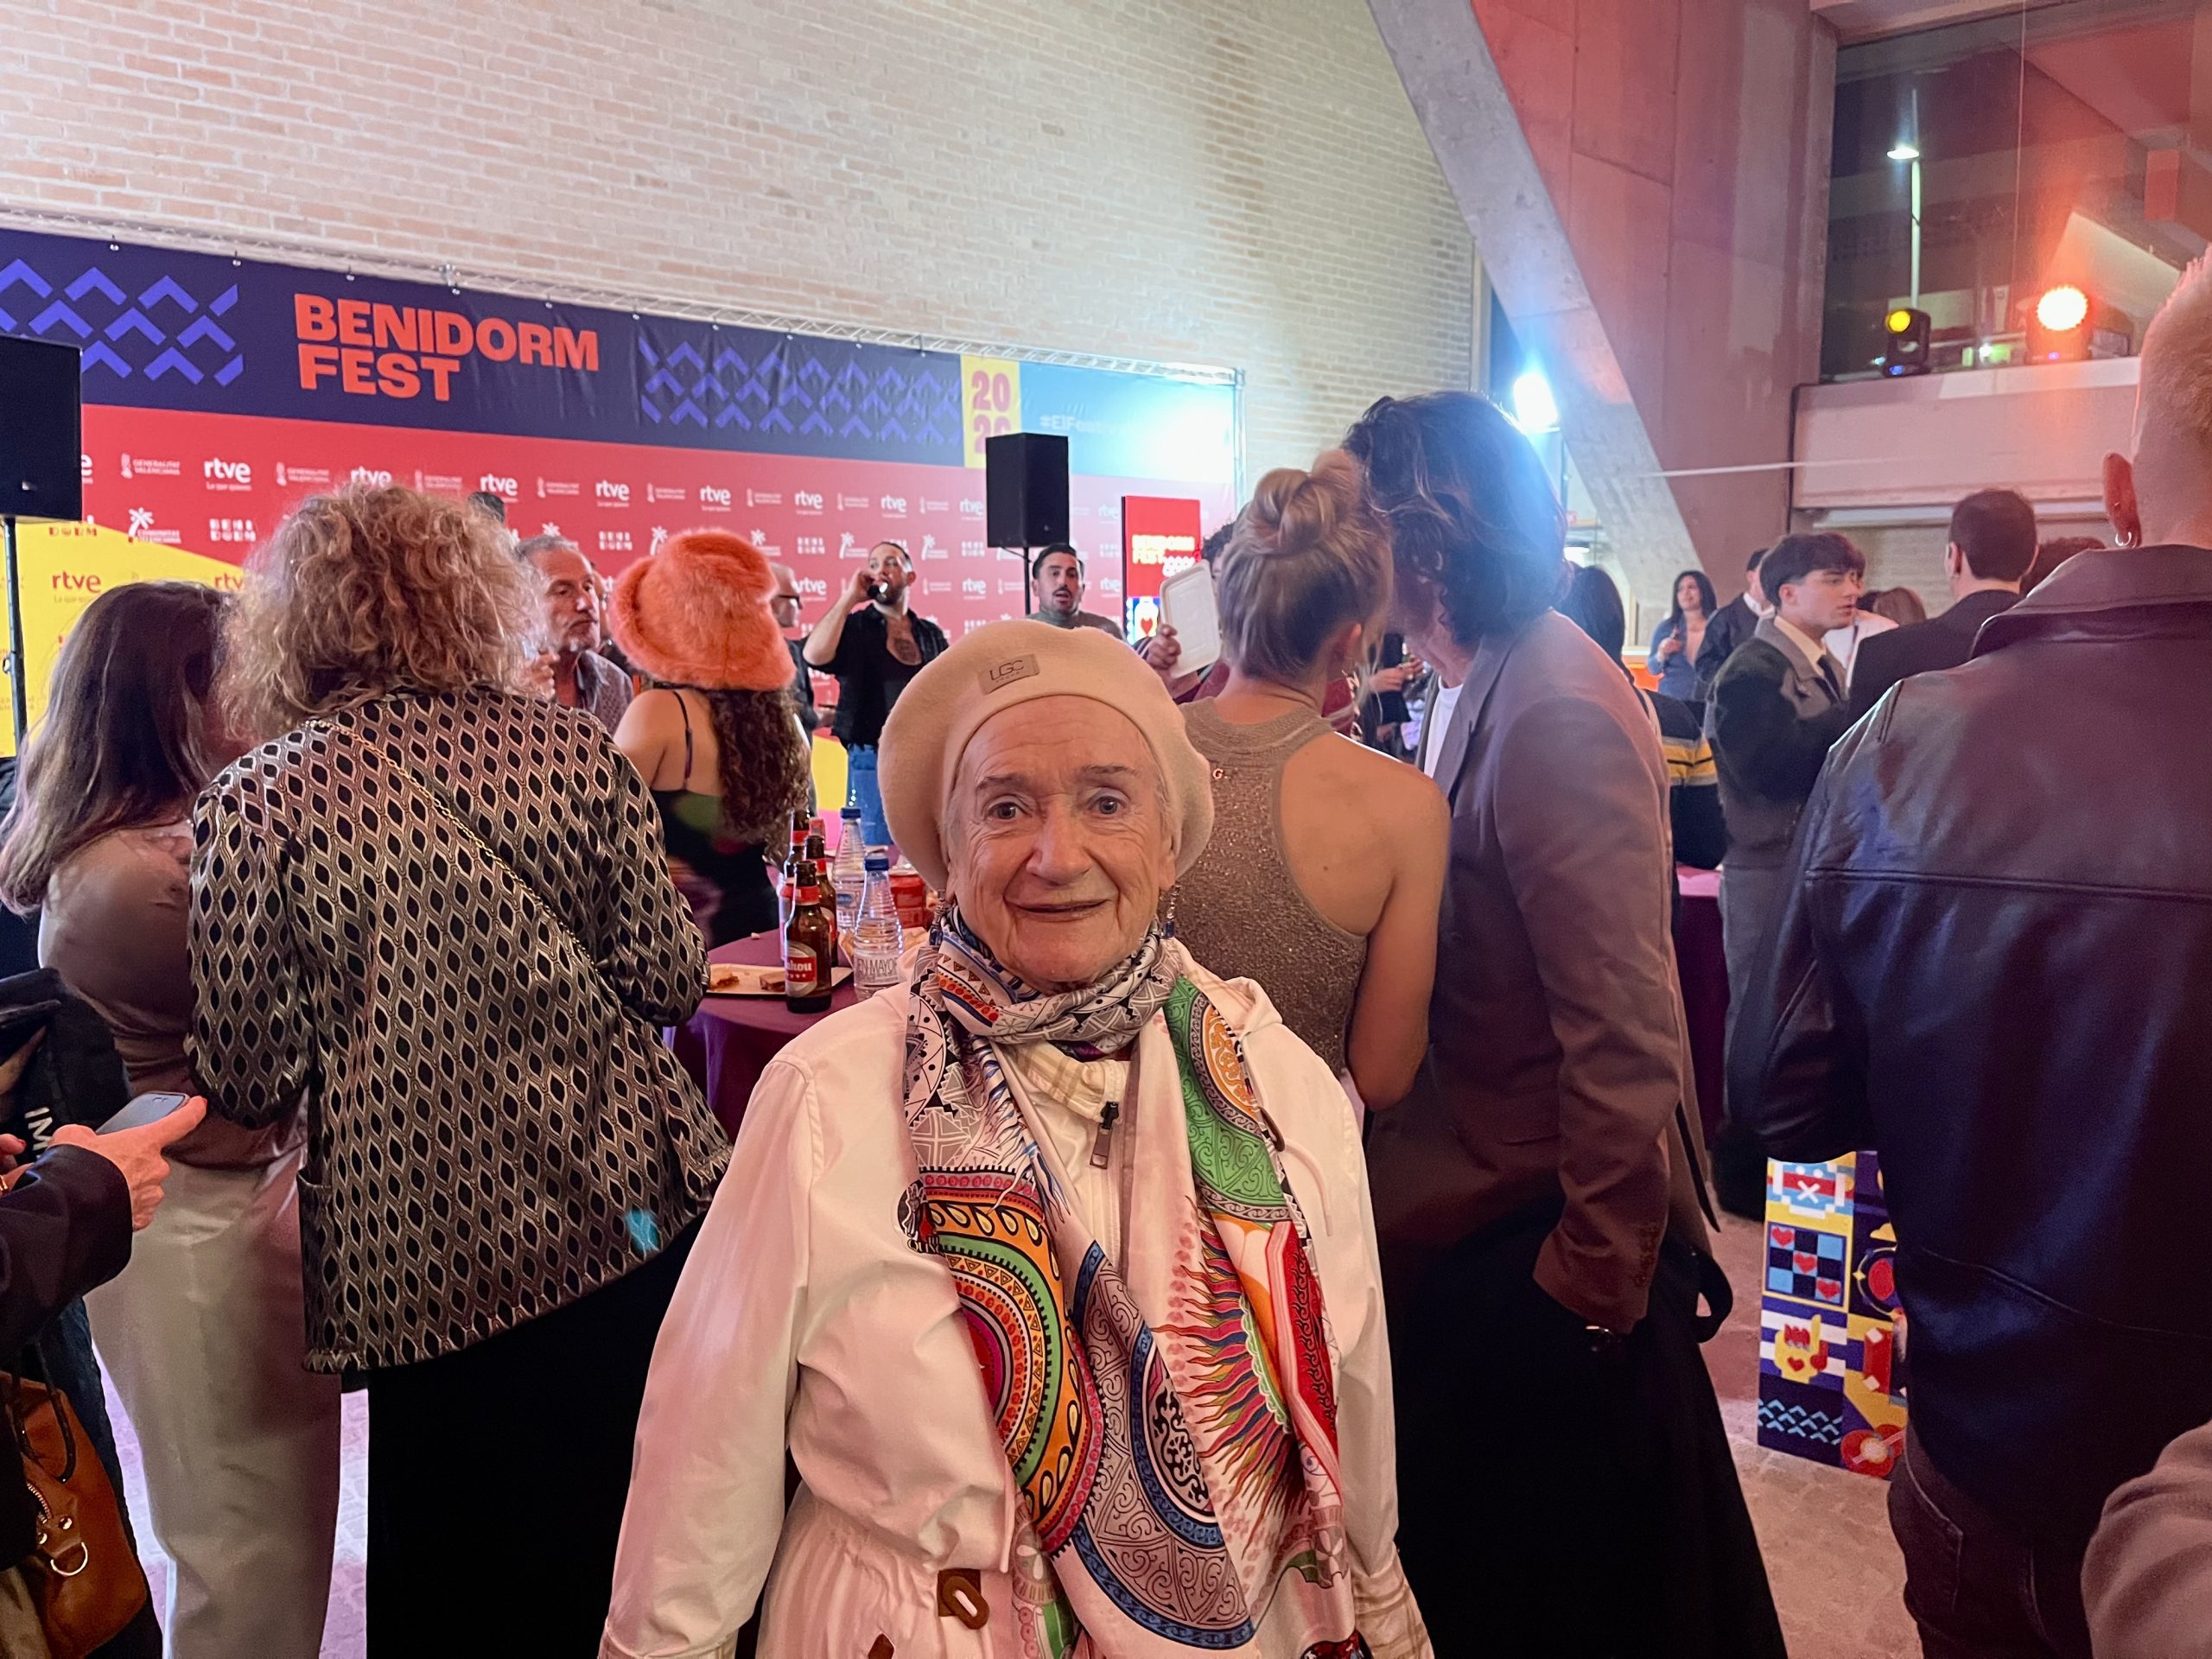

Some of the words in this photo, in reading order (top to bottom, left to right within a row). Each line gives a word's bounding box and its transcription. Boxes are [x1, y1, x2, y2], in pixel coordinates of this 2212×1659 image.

[294, 293, 599, 372] BENIDORM
[298, 343, 461, 402] FEST
[971, 370, 1011, 413] 20
[204, 457, 251, 484] rtve
[480, 474, 518, 496] rtve
[596, 480, 630, 501] rtve
[700, 485, 731, 505] rtve
[794, 491, 823, 509] rtve
[880, 494, 906, 512] rtve
[52, 570, 101, 594] rtve
[215, 572, 244, 589] rtv
[799, 577, 827, 595] rtve
